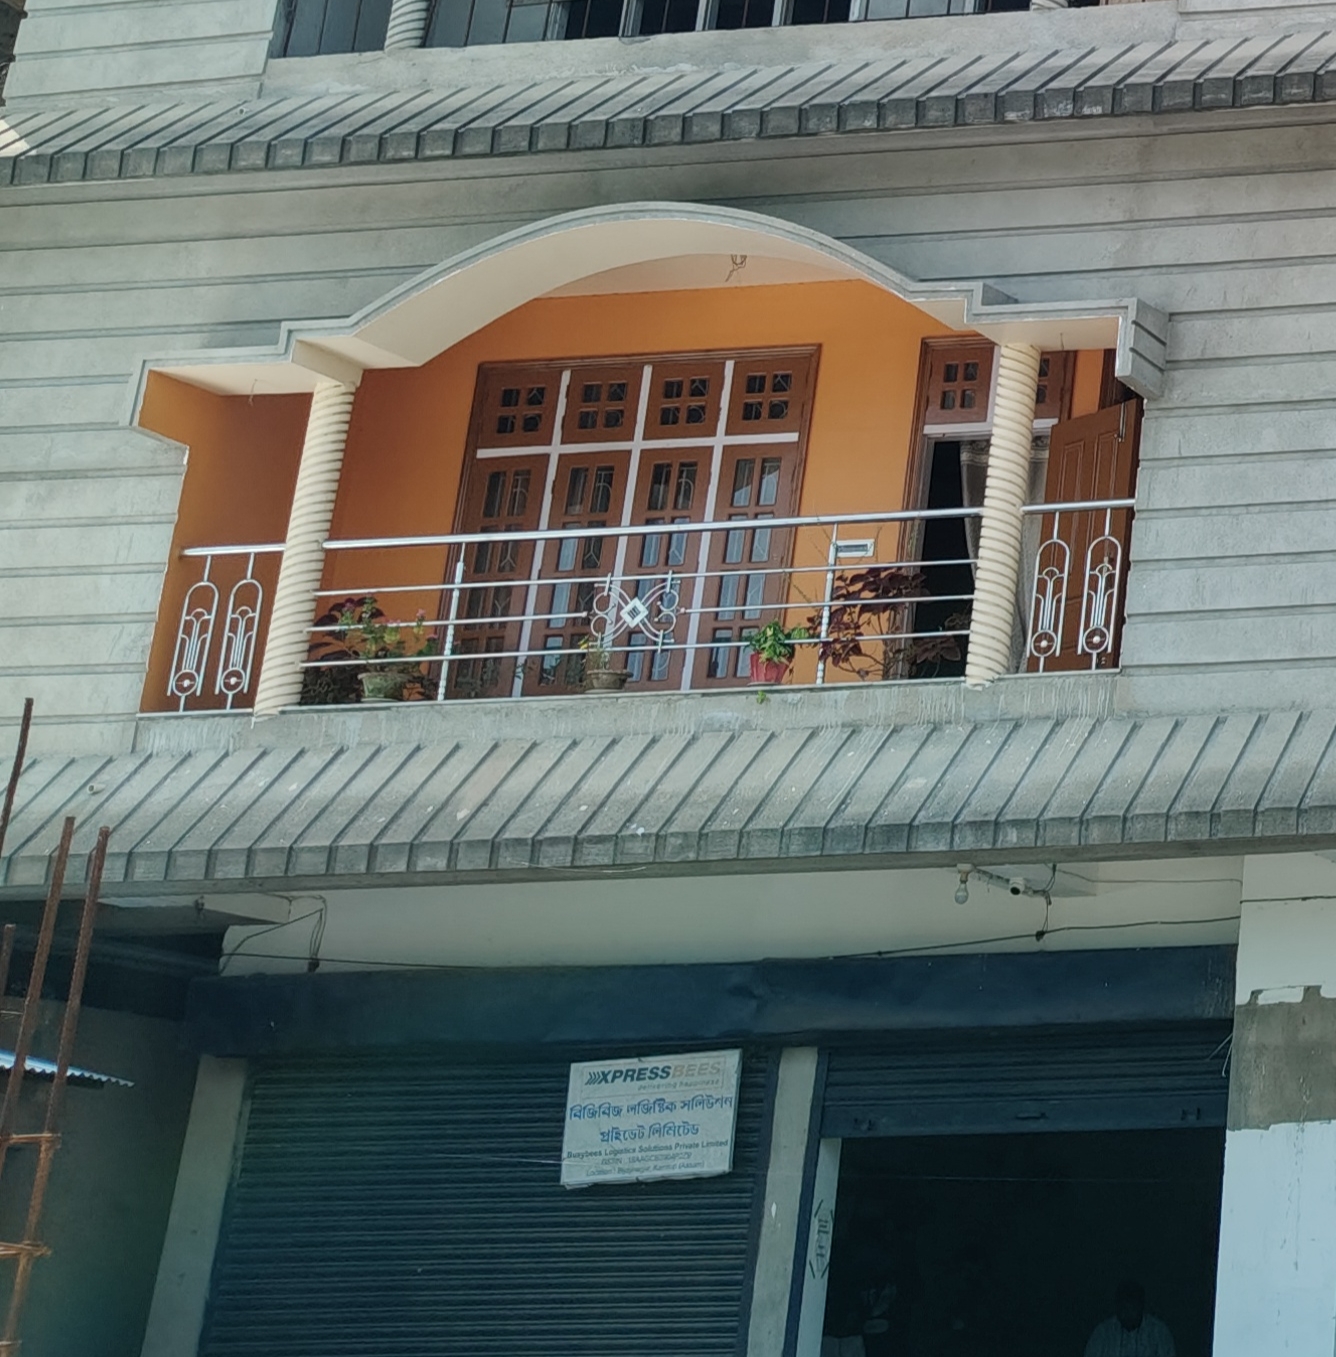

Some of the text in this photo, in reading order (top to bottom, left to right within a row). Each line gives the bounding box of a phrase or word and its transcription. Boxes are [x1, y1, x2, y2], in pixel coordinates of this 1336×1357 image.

[567, 1150, 603, 1160] Busybees
[674, 1141, 700, 1150] Private
[701, 1139, 729, 1148] Limited
